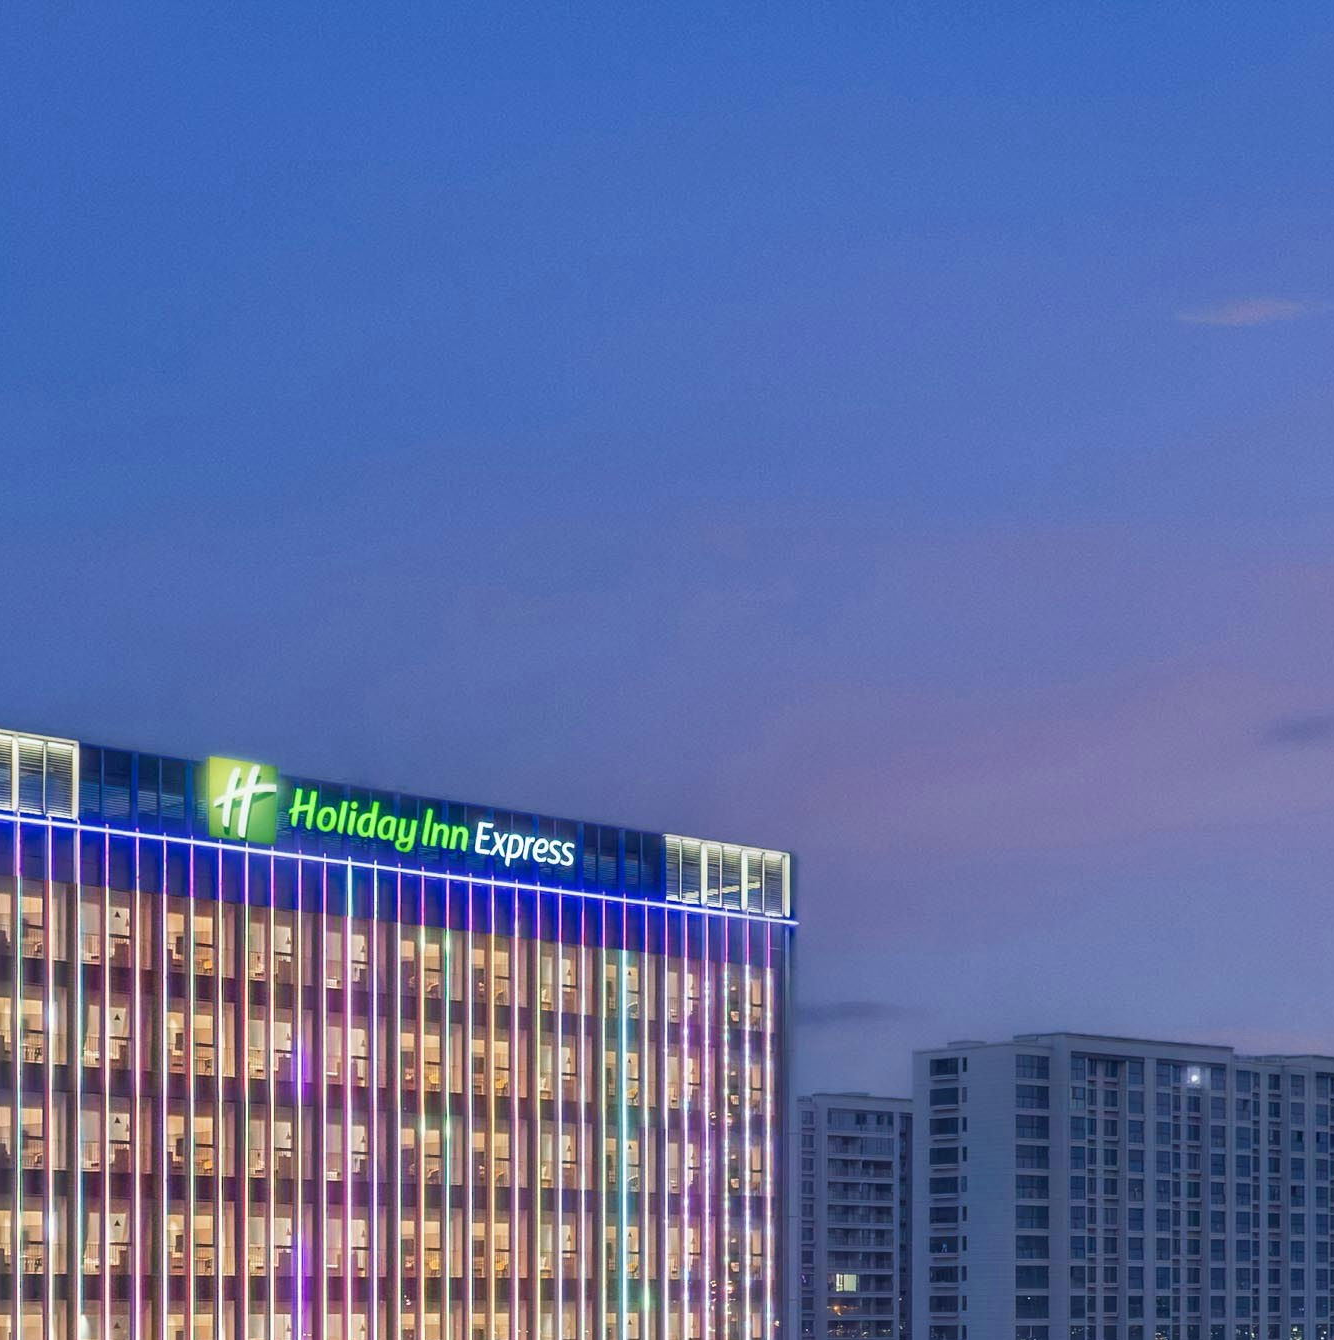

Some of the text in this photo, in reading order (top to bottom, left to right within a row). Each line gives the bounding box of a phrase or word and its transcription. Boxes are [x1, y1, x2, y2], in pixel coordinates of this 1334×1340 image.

[289, 787, 575, 867] Holiday Inn Express
